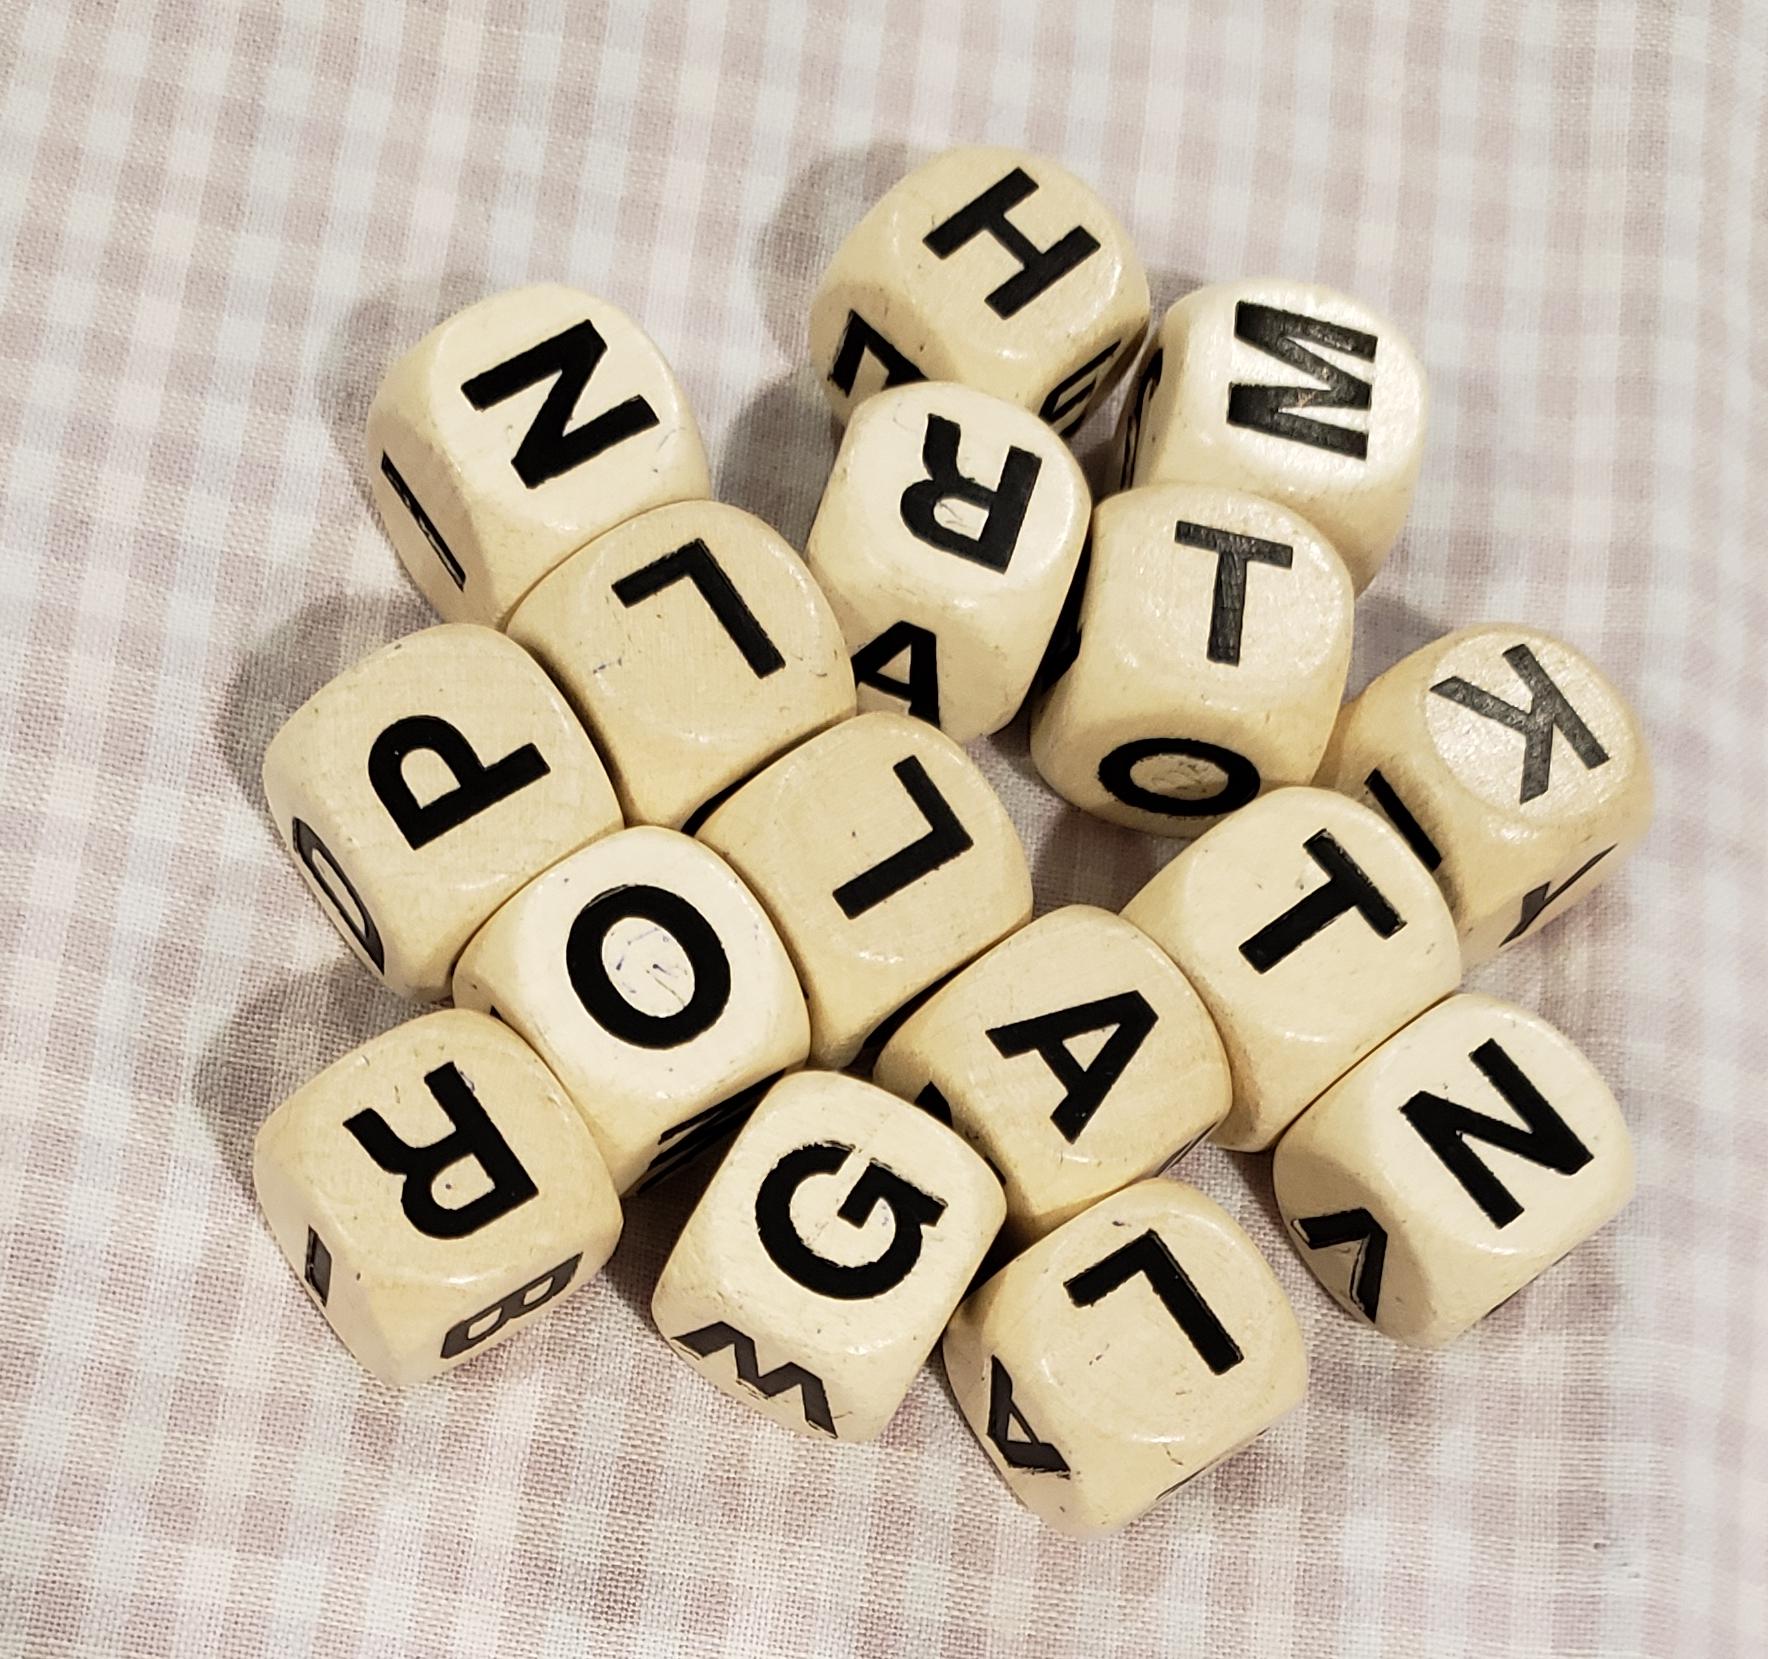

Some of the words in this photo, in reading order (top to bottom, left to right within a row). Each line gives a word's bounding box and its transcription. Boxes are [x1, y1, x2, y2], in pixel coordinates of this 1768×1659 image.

[923, 167, 1100, 319] H
[461, 318, 660, 489] N
[1227, 301, 1377, 460] M
[381, 450, 466, 592] I
[901, 414, 1042, 573] R
[612, 538, 786, 679] L
[1175, 521, 1293, 665] T
[850, 621, 941, 730] A
[1430, 644, 1610, 805] K
[368, 715, 550, 850] P
[833, 755, 973, 919] L
[1098, 737, 1261, 817] O
[566, 885, 730, 1049] O
[1239, 829, 1407, 973] T
[986, 991, 1158, 1144] A
[1399, 1039, 1594, 1229] N
[343, 1062, 538, 1239] R
[755, 1141, 948, 1300] G
[440, 1252, 583, 1359] B
[1063, 1229, 1244, 1375] L
[987, 1354, 1071, 1477] A
